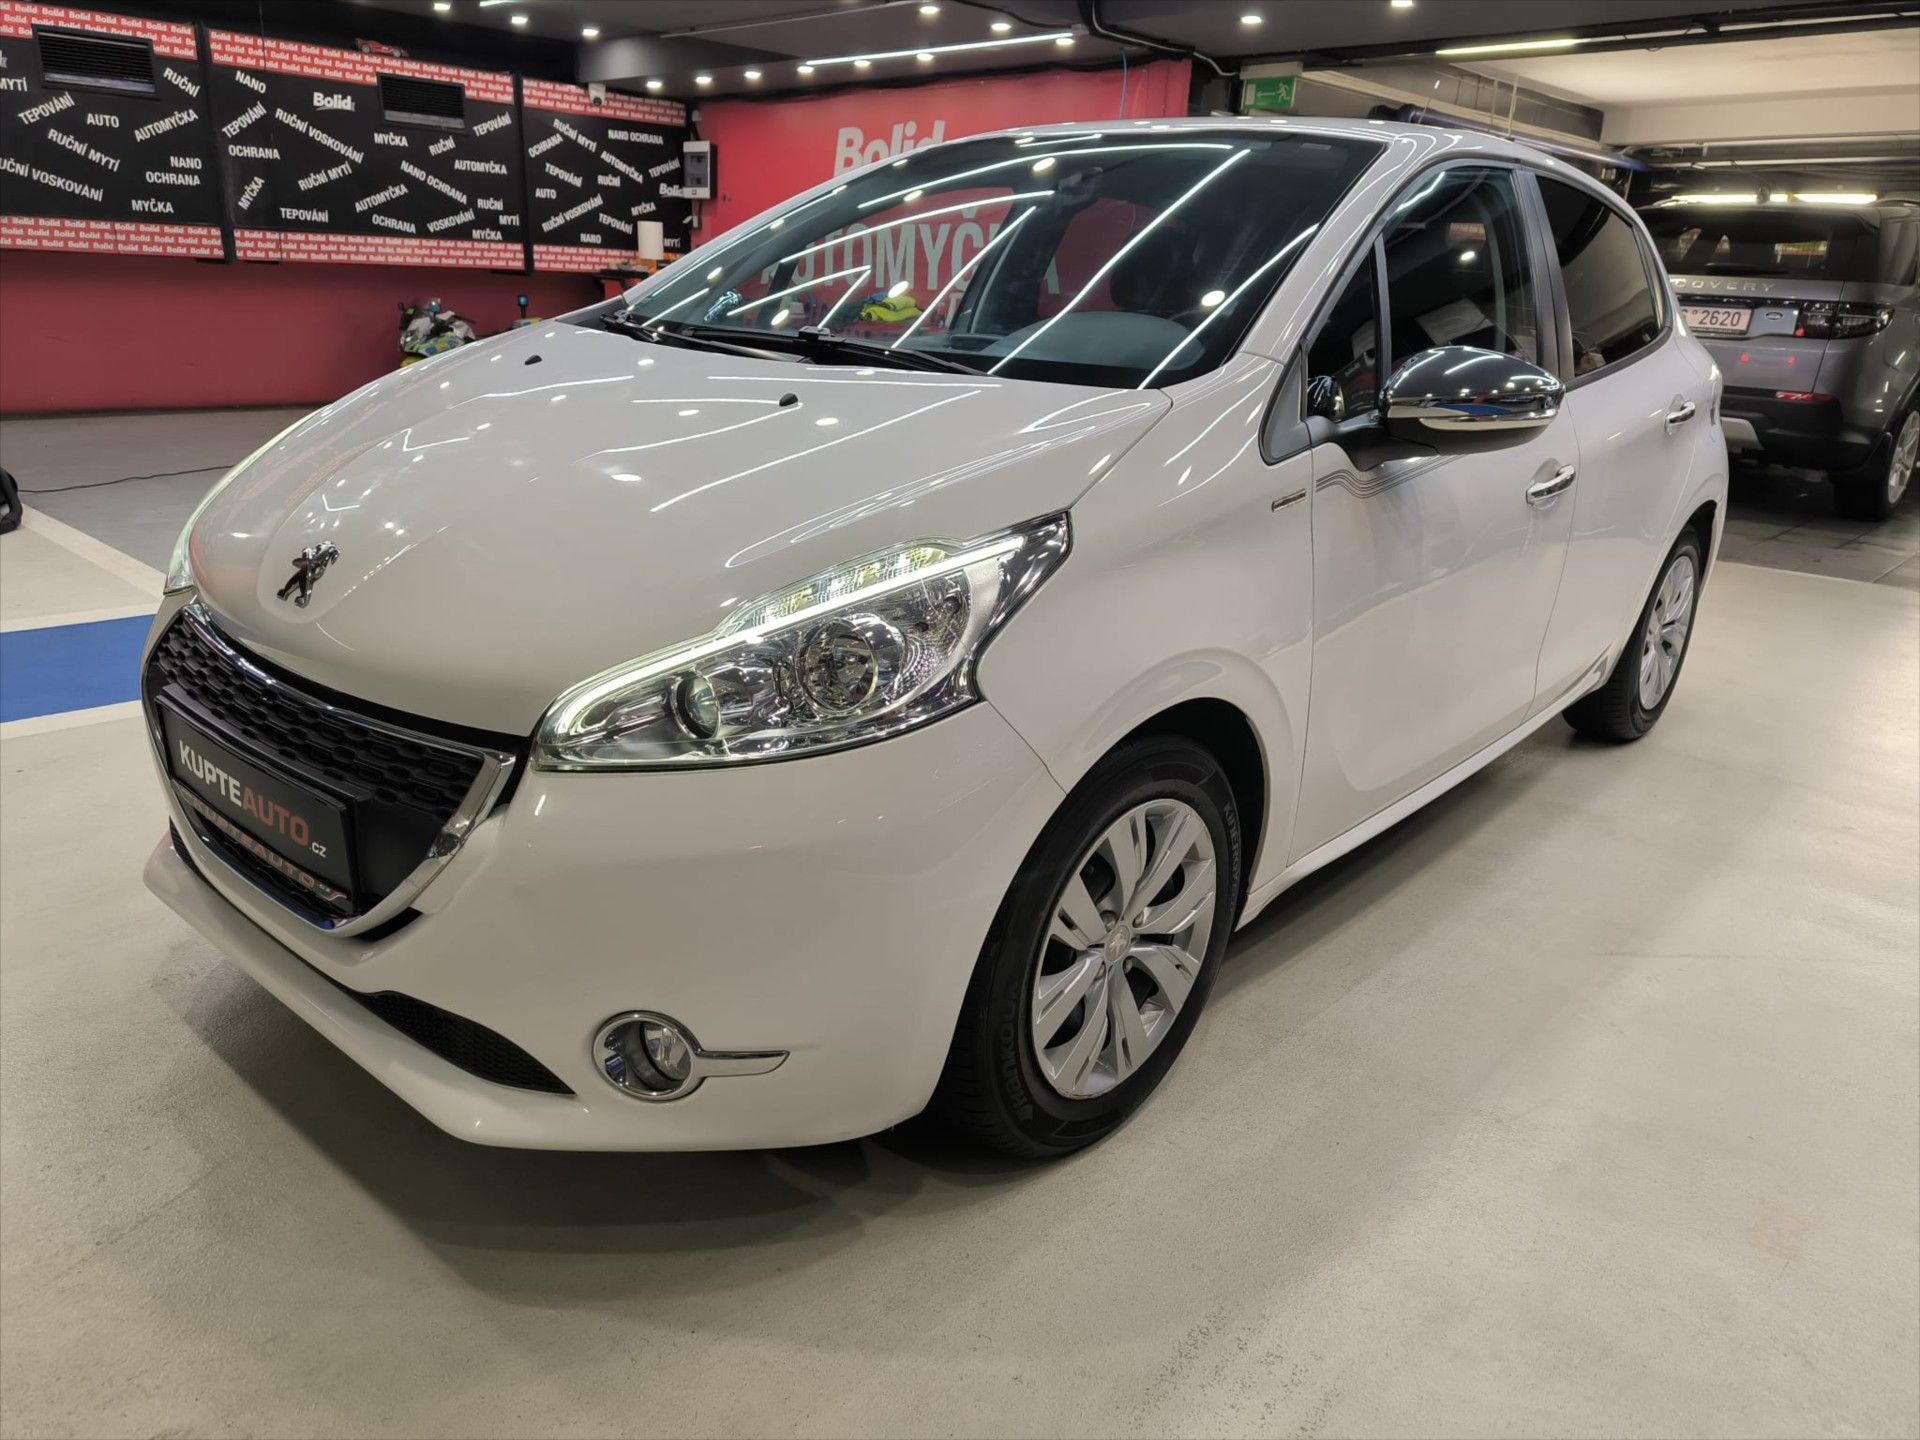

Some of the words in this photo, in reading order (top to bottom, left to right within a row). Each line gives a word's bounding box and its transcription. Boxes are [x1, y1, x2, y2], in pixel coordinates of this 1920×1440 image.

[0, 2, 10, 10] lid
[0, 25, 13, 33] lid
[18, 27, 32, 36] Bol
[154, 45, 170, 53] olid
[210, 42, 221, 50] lid
[0, 76, 27, 91] MYTÍ
[164, 67, 199, 98] RUČNÍ
[235, 70, 266, 94] NANO
[366, 74, 376, 82] Bol
[18, 91, 75, 126] TEPOVÁNÍ
[313, 91, 355, 112] Bolid
[87, 113, 119, 128] AUTO
[134, 108, 199, 142] AUTOMYČKA
[222, 100, 267, 138] TEPOVÁNÍ
[473, 111, 512, 137] TEPOVÁNÍ
[275, 107, 309, 133] RUČNÍ
[309, 126, 364, 164] VOSKOVÁNÍ
[374, 131, 408, 148] MYČKA
[429, 135, 456, 156] RUČNÍ
[528, 132, 563, 159] OCHRANA
[48, 128, 88, 157] RUČNÍ
[88, 147, 120, 172] MYTÍ
[228, 144, 280, 160] OCHRANA
[170, 156, 202, 170] NANO
[454, 159, 508, 175] AUTOMYČKA
[31, 169, 104, 202] VOSKOVÁNÍ
[146, 171, 200, 186] OCHRANA
[298, 170, 327, 192] RUČNÍ
[327, 161, 352, 183] MYTÍ
[400, 160, 426, 182] NANO
[426, 175, 467, 205] OCHRANA
[545, 162, 583, 188] TEPOVÁNÍ
[238, 175, 265, 211] MYČKA
[354, 182, 408, 213] AUTOMYČKA
[477, 195, 503, 211] RUČNÍ
[535, 187, 557, 200] AUTO
[131, 198, 174, 214] MYČKA
[280, 206, 328, 223] TEPOVÁNÍ
[372, 213, 416, 234] OCHRANA
[427, 207, 475, 233] VOSKOVÁNÍ
[499, 212, 520, 226] MYTÍ
[472, 226, 503, 241] MYČKA
